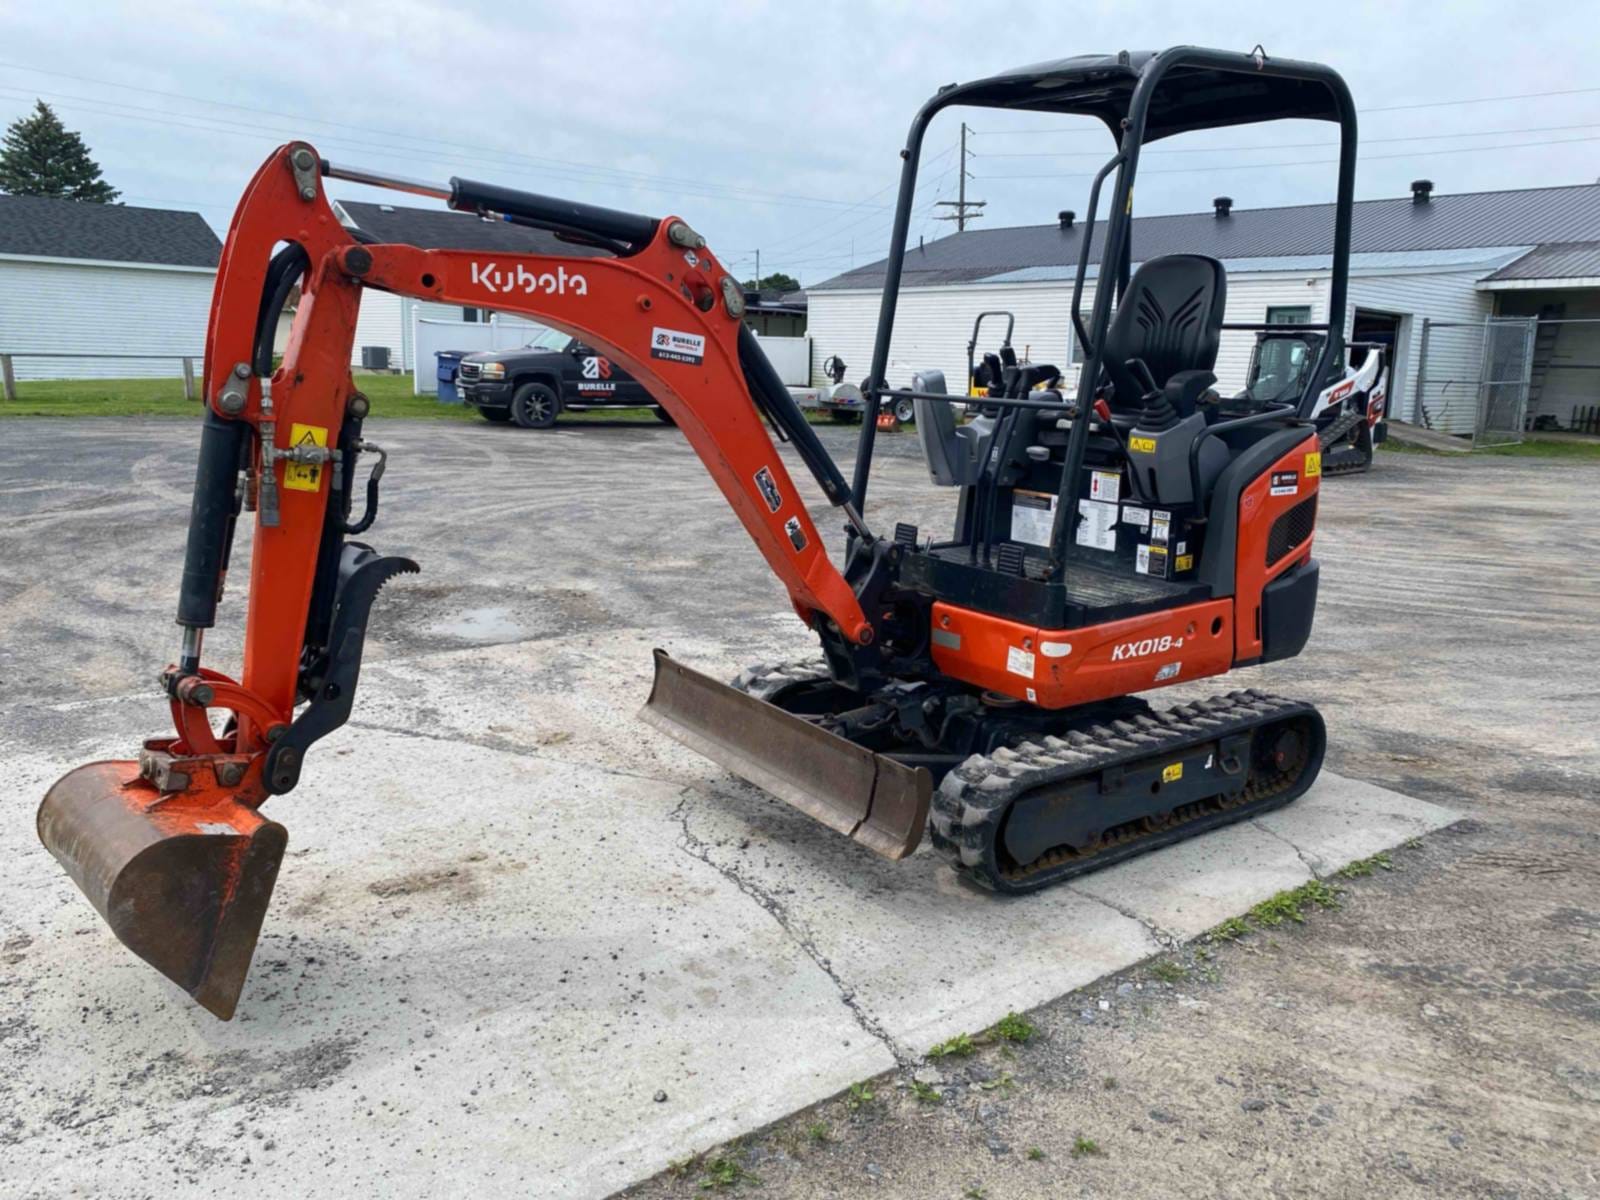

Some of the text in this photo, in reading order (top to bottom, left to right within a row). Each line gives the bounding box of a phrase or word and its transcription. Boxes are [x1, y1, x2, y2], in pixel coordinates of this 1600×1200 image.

[471, 262, 588, 295] Kubota
[672, 336, 701, 347] BURELLE
[577, 383, 616, 391] BURELLE
[1111, 635, 1184, 661] KX018-4
